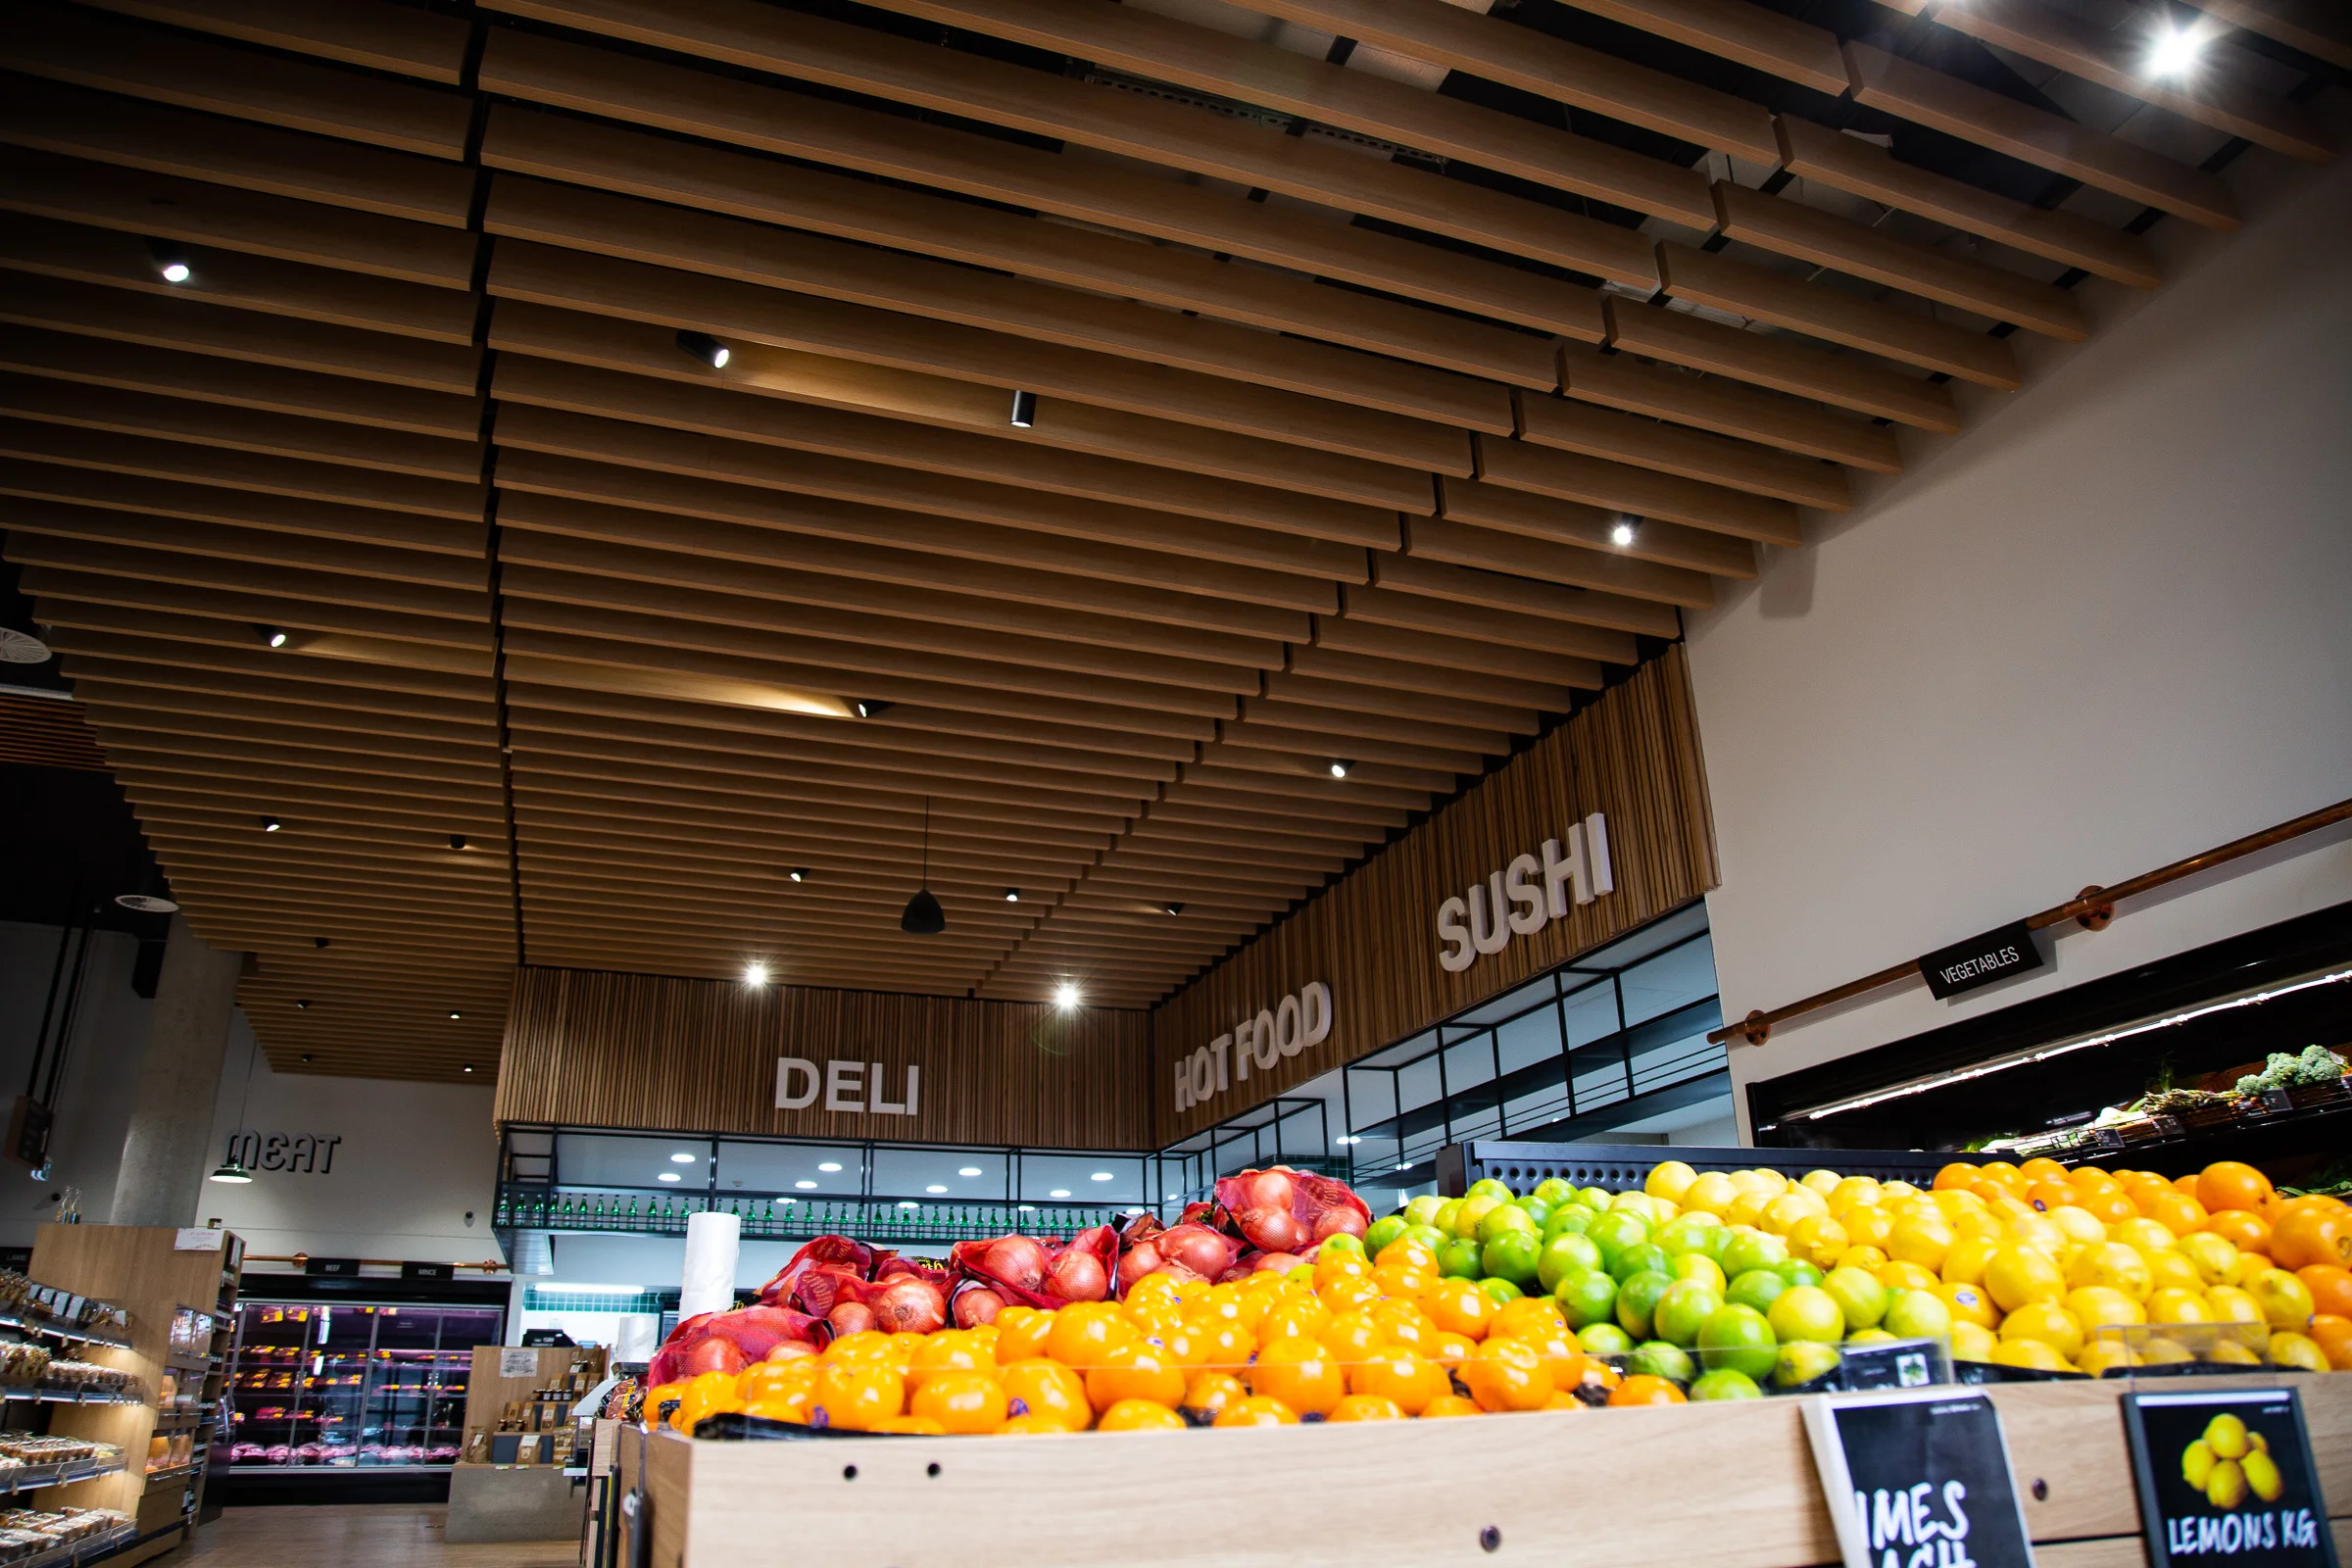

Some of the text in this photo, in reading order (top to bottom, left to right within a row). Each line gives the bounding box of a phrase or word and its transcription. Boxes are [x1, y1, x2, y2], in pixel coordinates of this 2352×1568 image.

[1438, 812, 1614, 972] SUSHI
[1939, 947, 2020, 984] VEGETABLES
[1175, 982, 1332, 1112] HOT FOOD
[775, 1057, 919, 1115] DELI
[220, 1129, 342, 1174] MEAT
[1854, 1480, 1970, 1550] IMES
[2168, 1507, 2319, 1555] LEMONS KG
